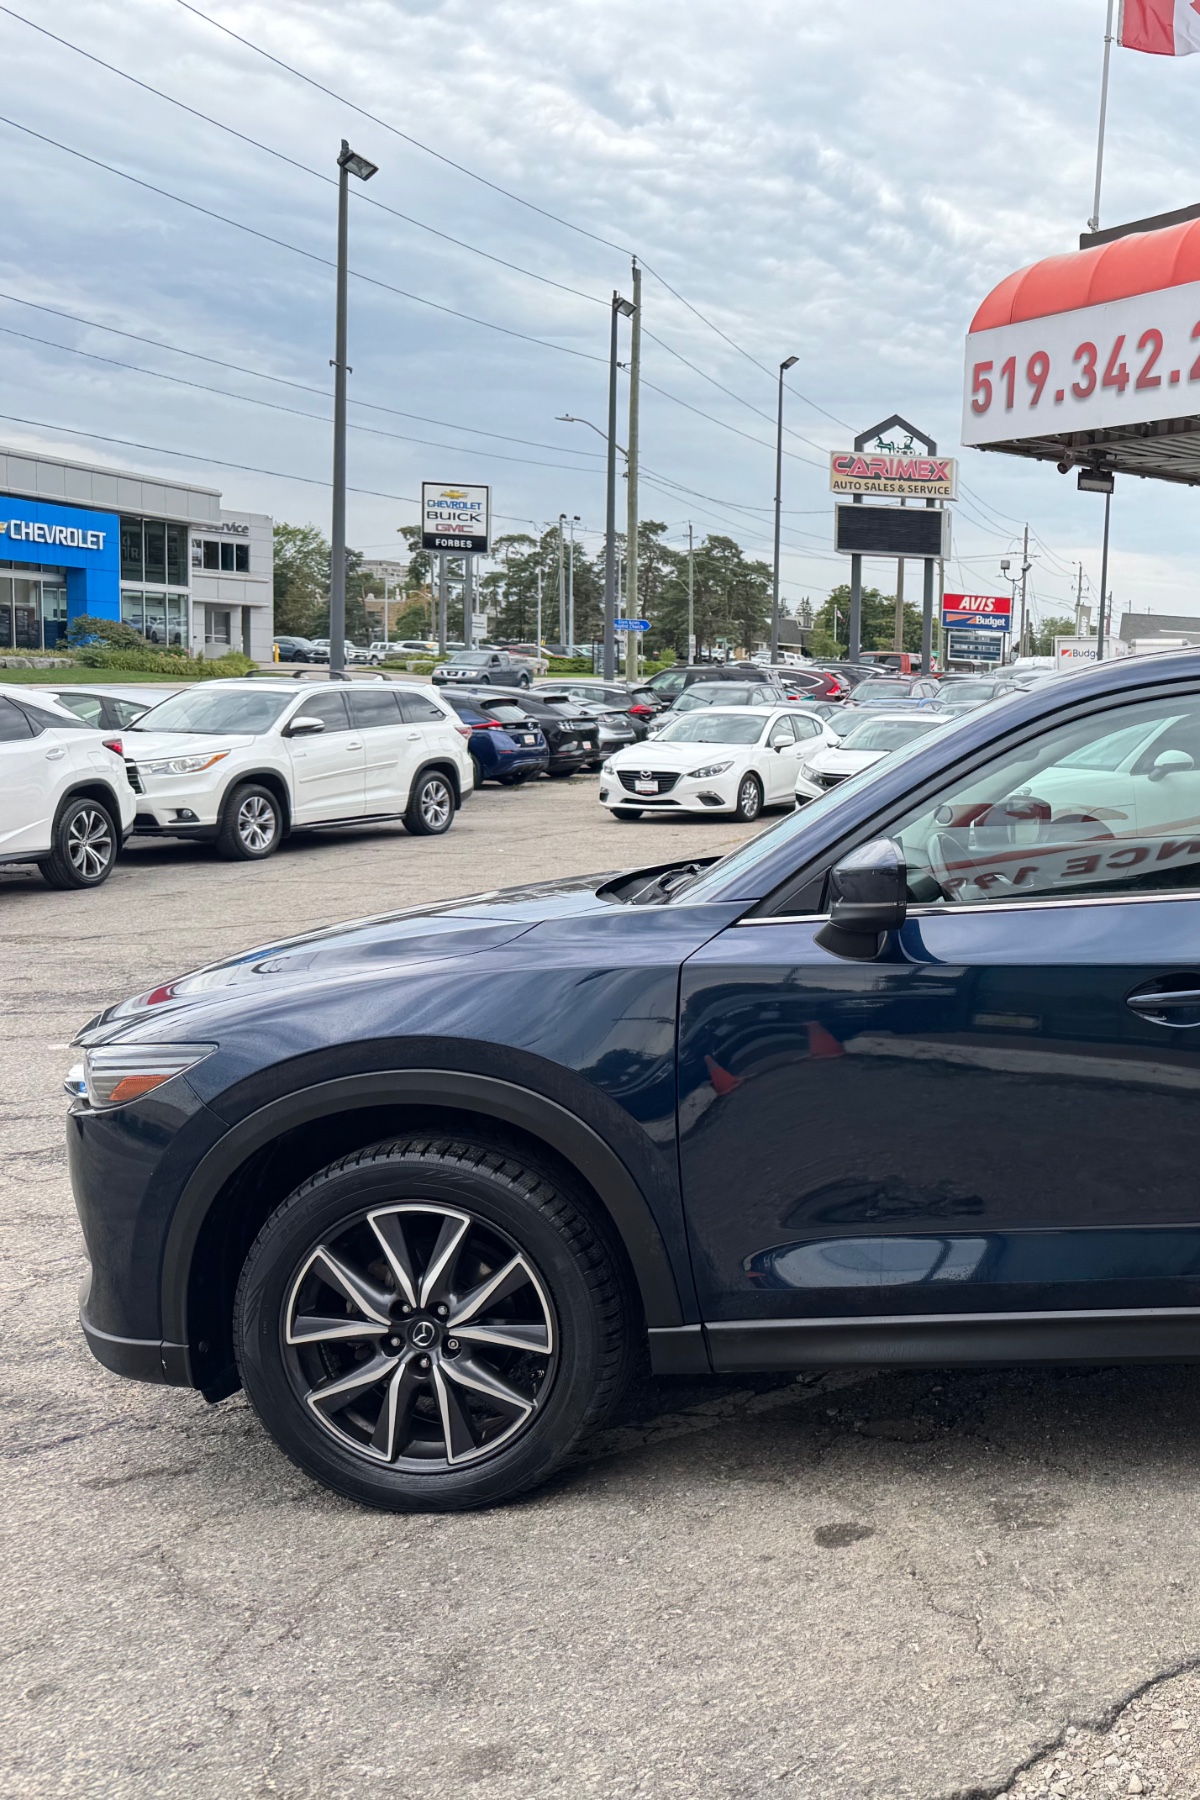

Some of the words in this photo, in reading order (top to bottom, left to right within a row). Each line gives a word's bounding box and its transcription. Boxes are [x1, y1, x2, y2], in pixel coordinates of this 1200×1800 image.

[832, 456, 951, 480] CARIMEX
[833, 481, 861, 490] AUTO
[864, 482, 895, 493] SALES
[898, 484, 905, 493] &
[908, 484, 950, 495] SERVICE
[426, 500, 483, 510] CHEVROLET
[427, 511, 482, 523] BUICK
[435, 523, 474, 533] GMC
[10, 520, 106, 550] CHEVROLET
[435, 538, 473, 549] FORBES
[958, 596, 996, 611] AVIS
[976, 615, 1006, 628] Budget
[1073, 649, 1098, 660] Budg
